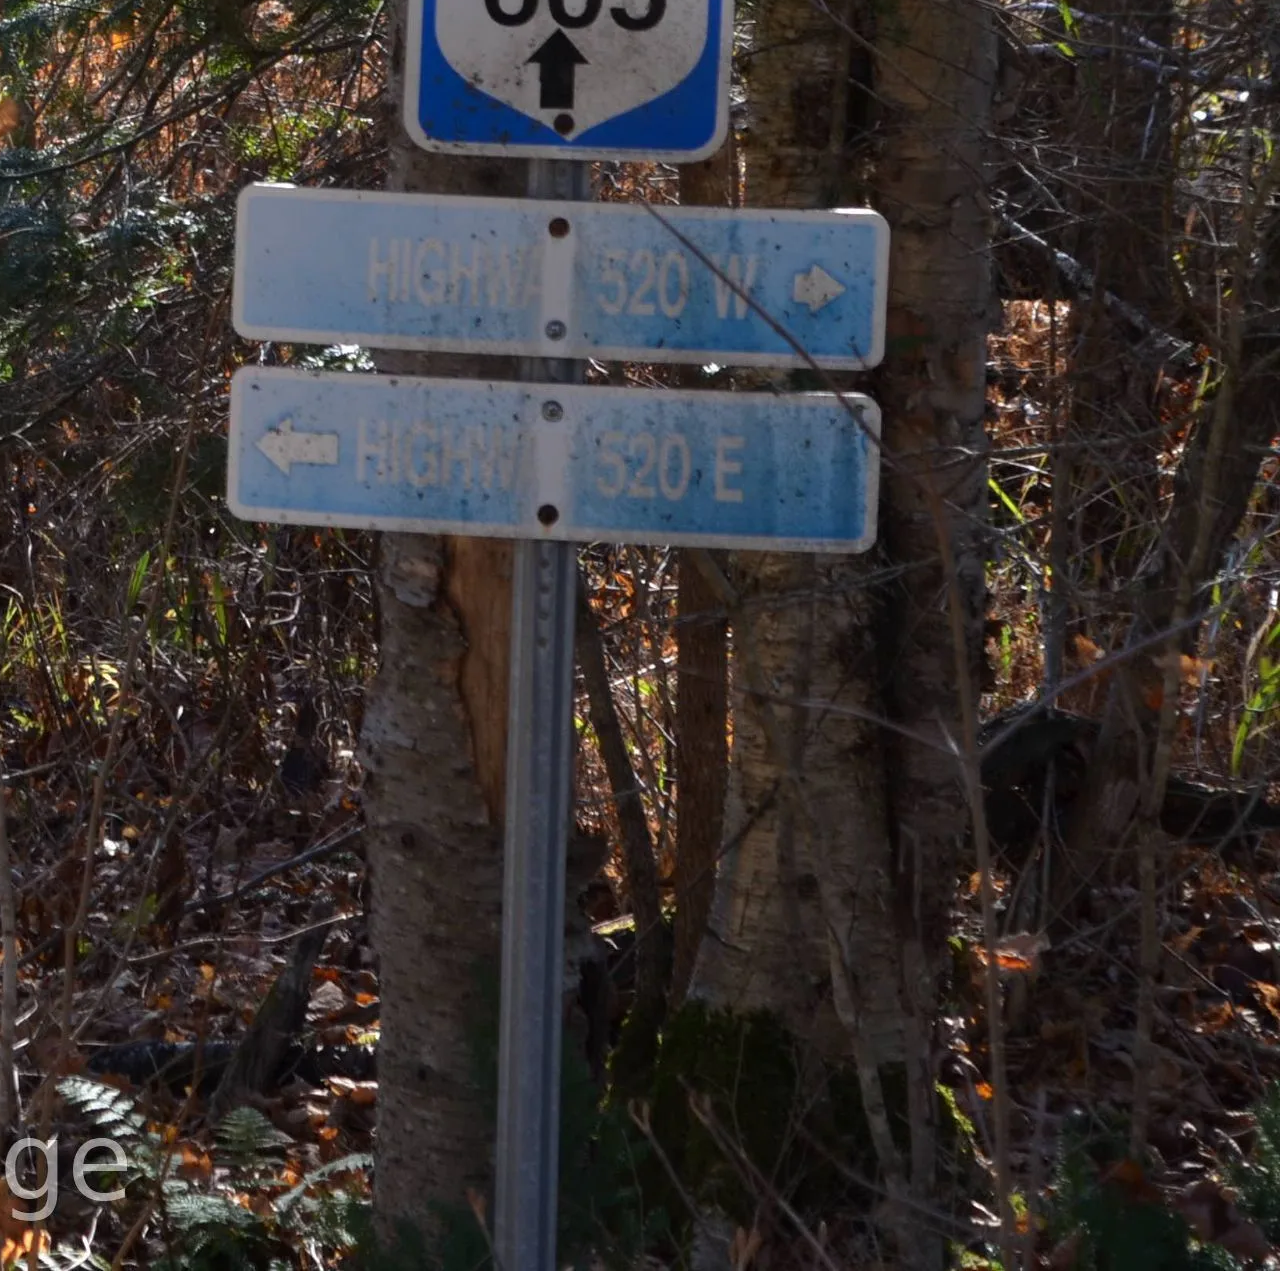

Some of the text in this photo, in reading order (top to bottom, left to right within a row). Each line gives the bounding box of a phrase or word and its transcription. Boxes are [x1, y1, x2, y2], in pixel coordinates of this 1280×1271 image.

[368, 238, 760, 320] HIGHWA 520 W
[597, 430, 691, 501] 520
[715, 436, 745, 503] E
